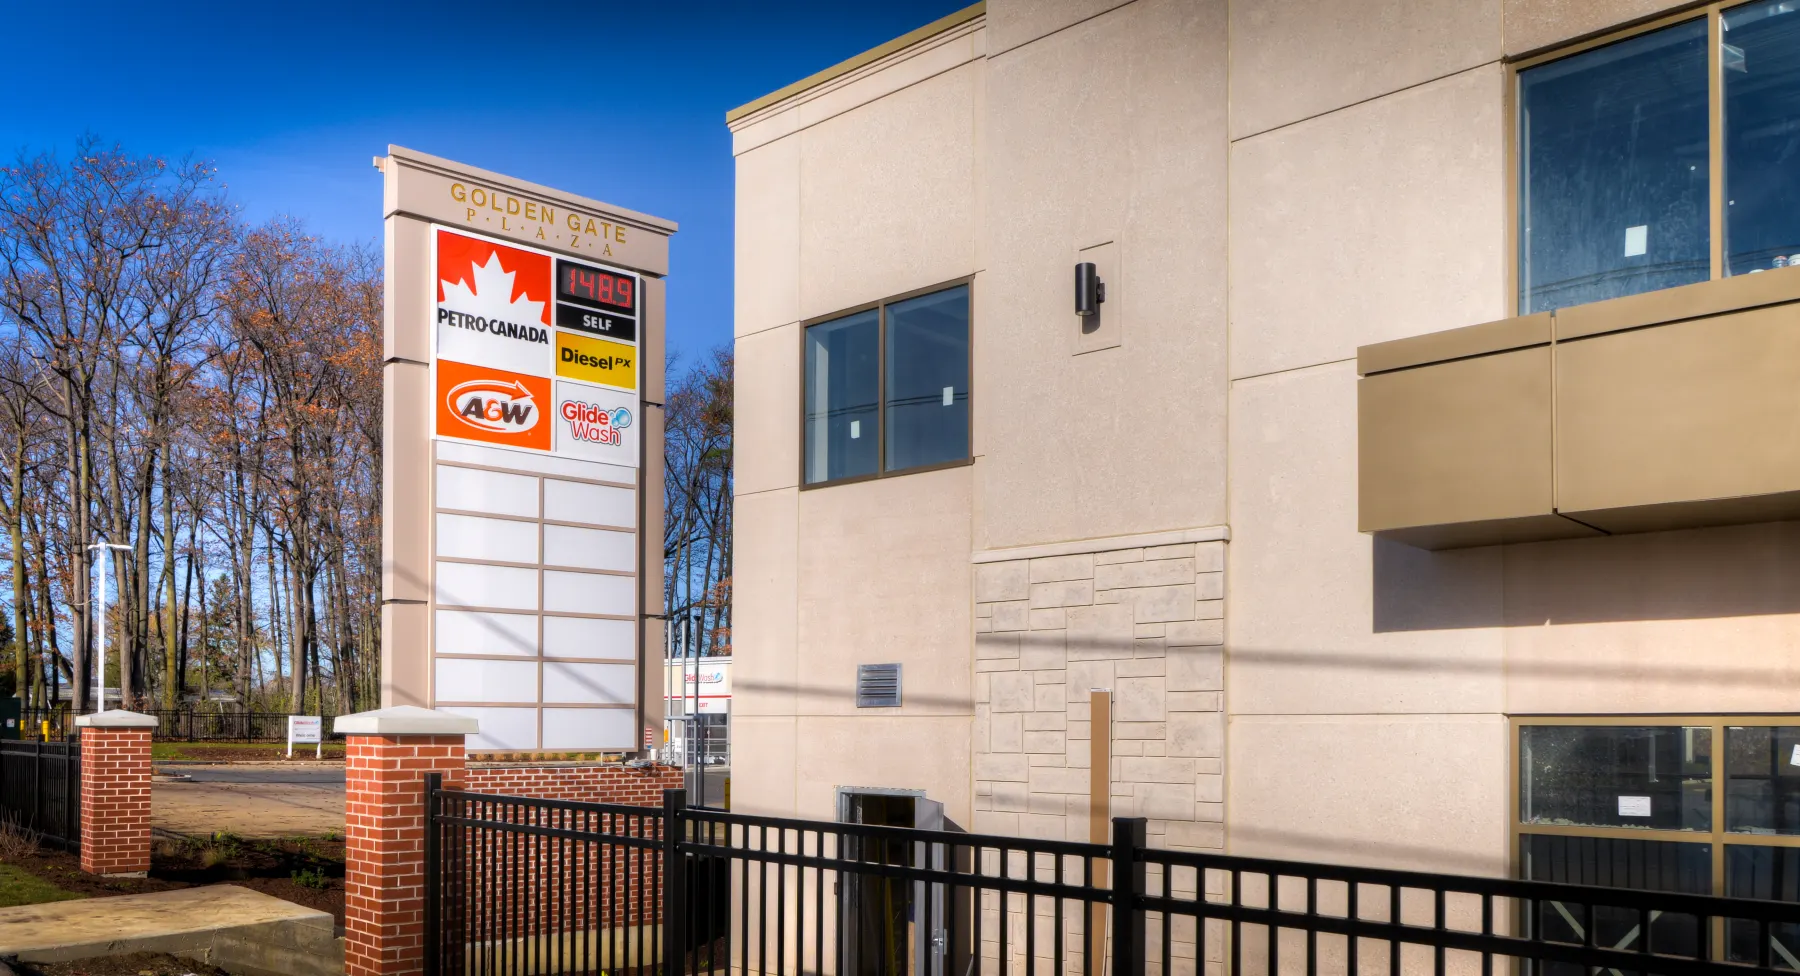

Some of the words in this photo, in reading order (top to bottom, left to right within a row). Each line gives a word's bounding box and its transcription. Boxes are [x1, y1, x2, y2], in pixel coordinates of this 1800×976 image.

[450, 183, 554, 225] GOLDEN
[567, 213, 627, 244] GATE
[583, 314, 612, 331] SELF
[561, 346, 613, 370] Diesel
[615, 358, 631, 368] PX
[461, 396, 532, 425] A&W
[562, 402, 609, 426] Glide
[571, 420, 621, 447] Wash
